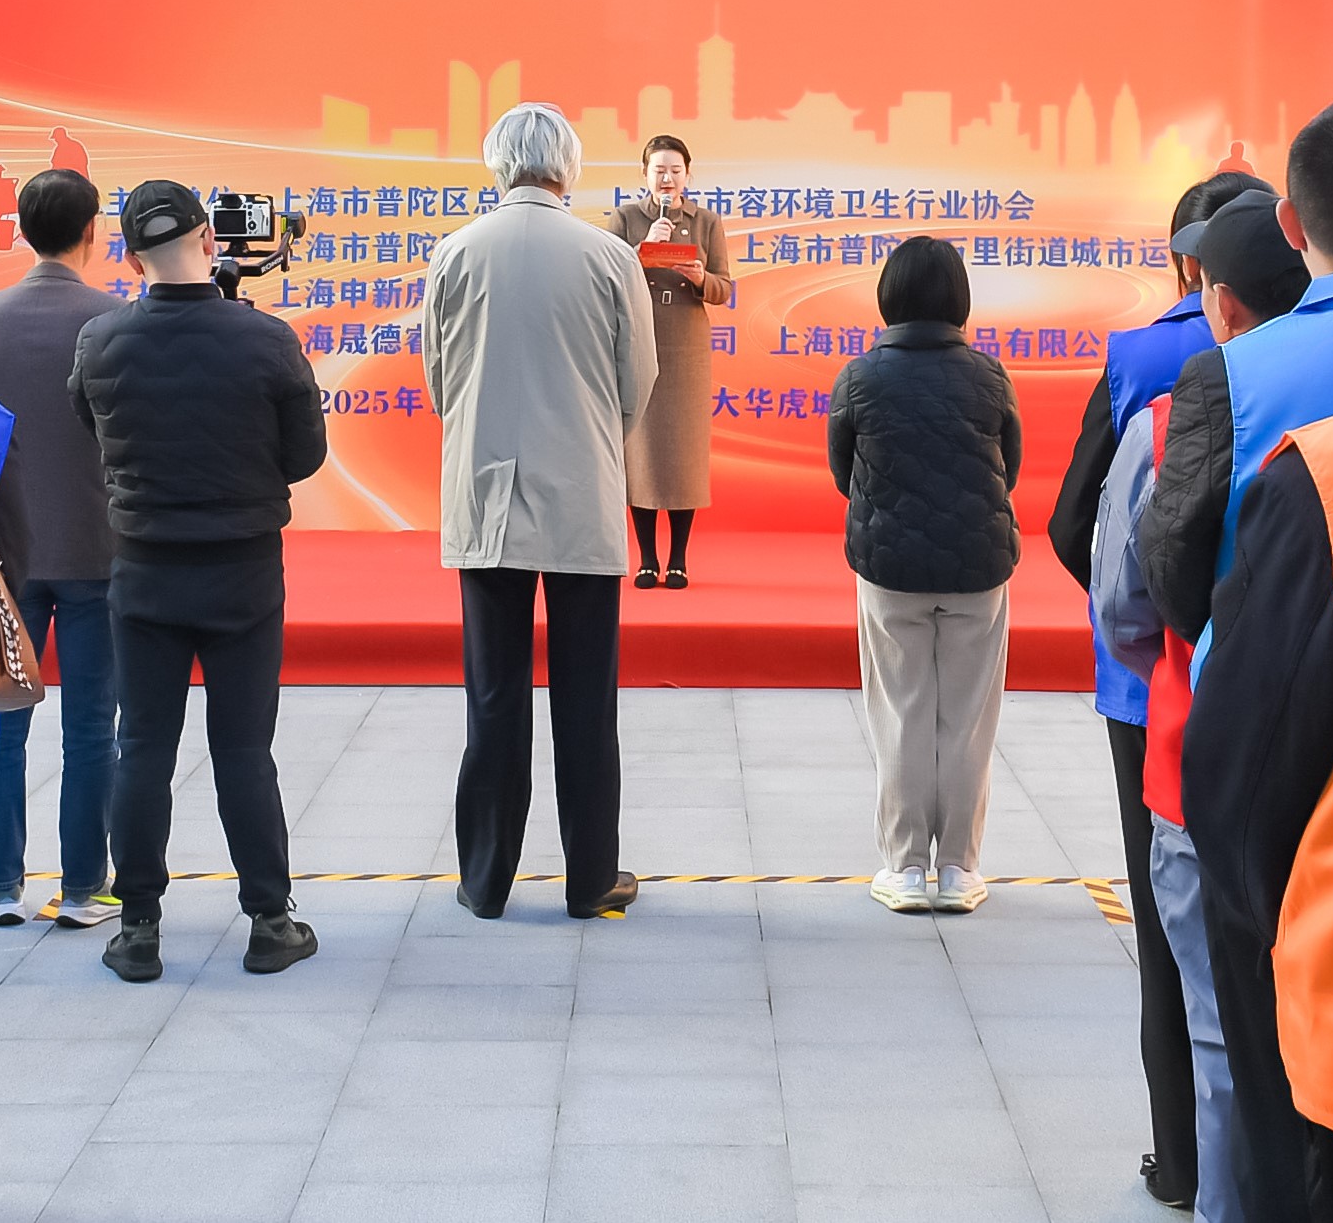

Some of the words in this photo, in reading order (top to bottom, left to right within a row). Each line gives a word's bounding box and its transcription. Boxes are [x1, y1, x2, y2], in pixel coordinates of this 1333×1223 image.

[274, 185, 571, 217] 上海市普陀区总
[603, 186, 1035, 221] 上市容环境卫生行业协会
[288, 231, 449, 264] 海市普陀
[319, 386, 438, 418] 2025年
